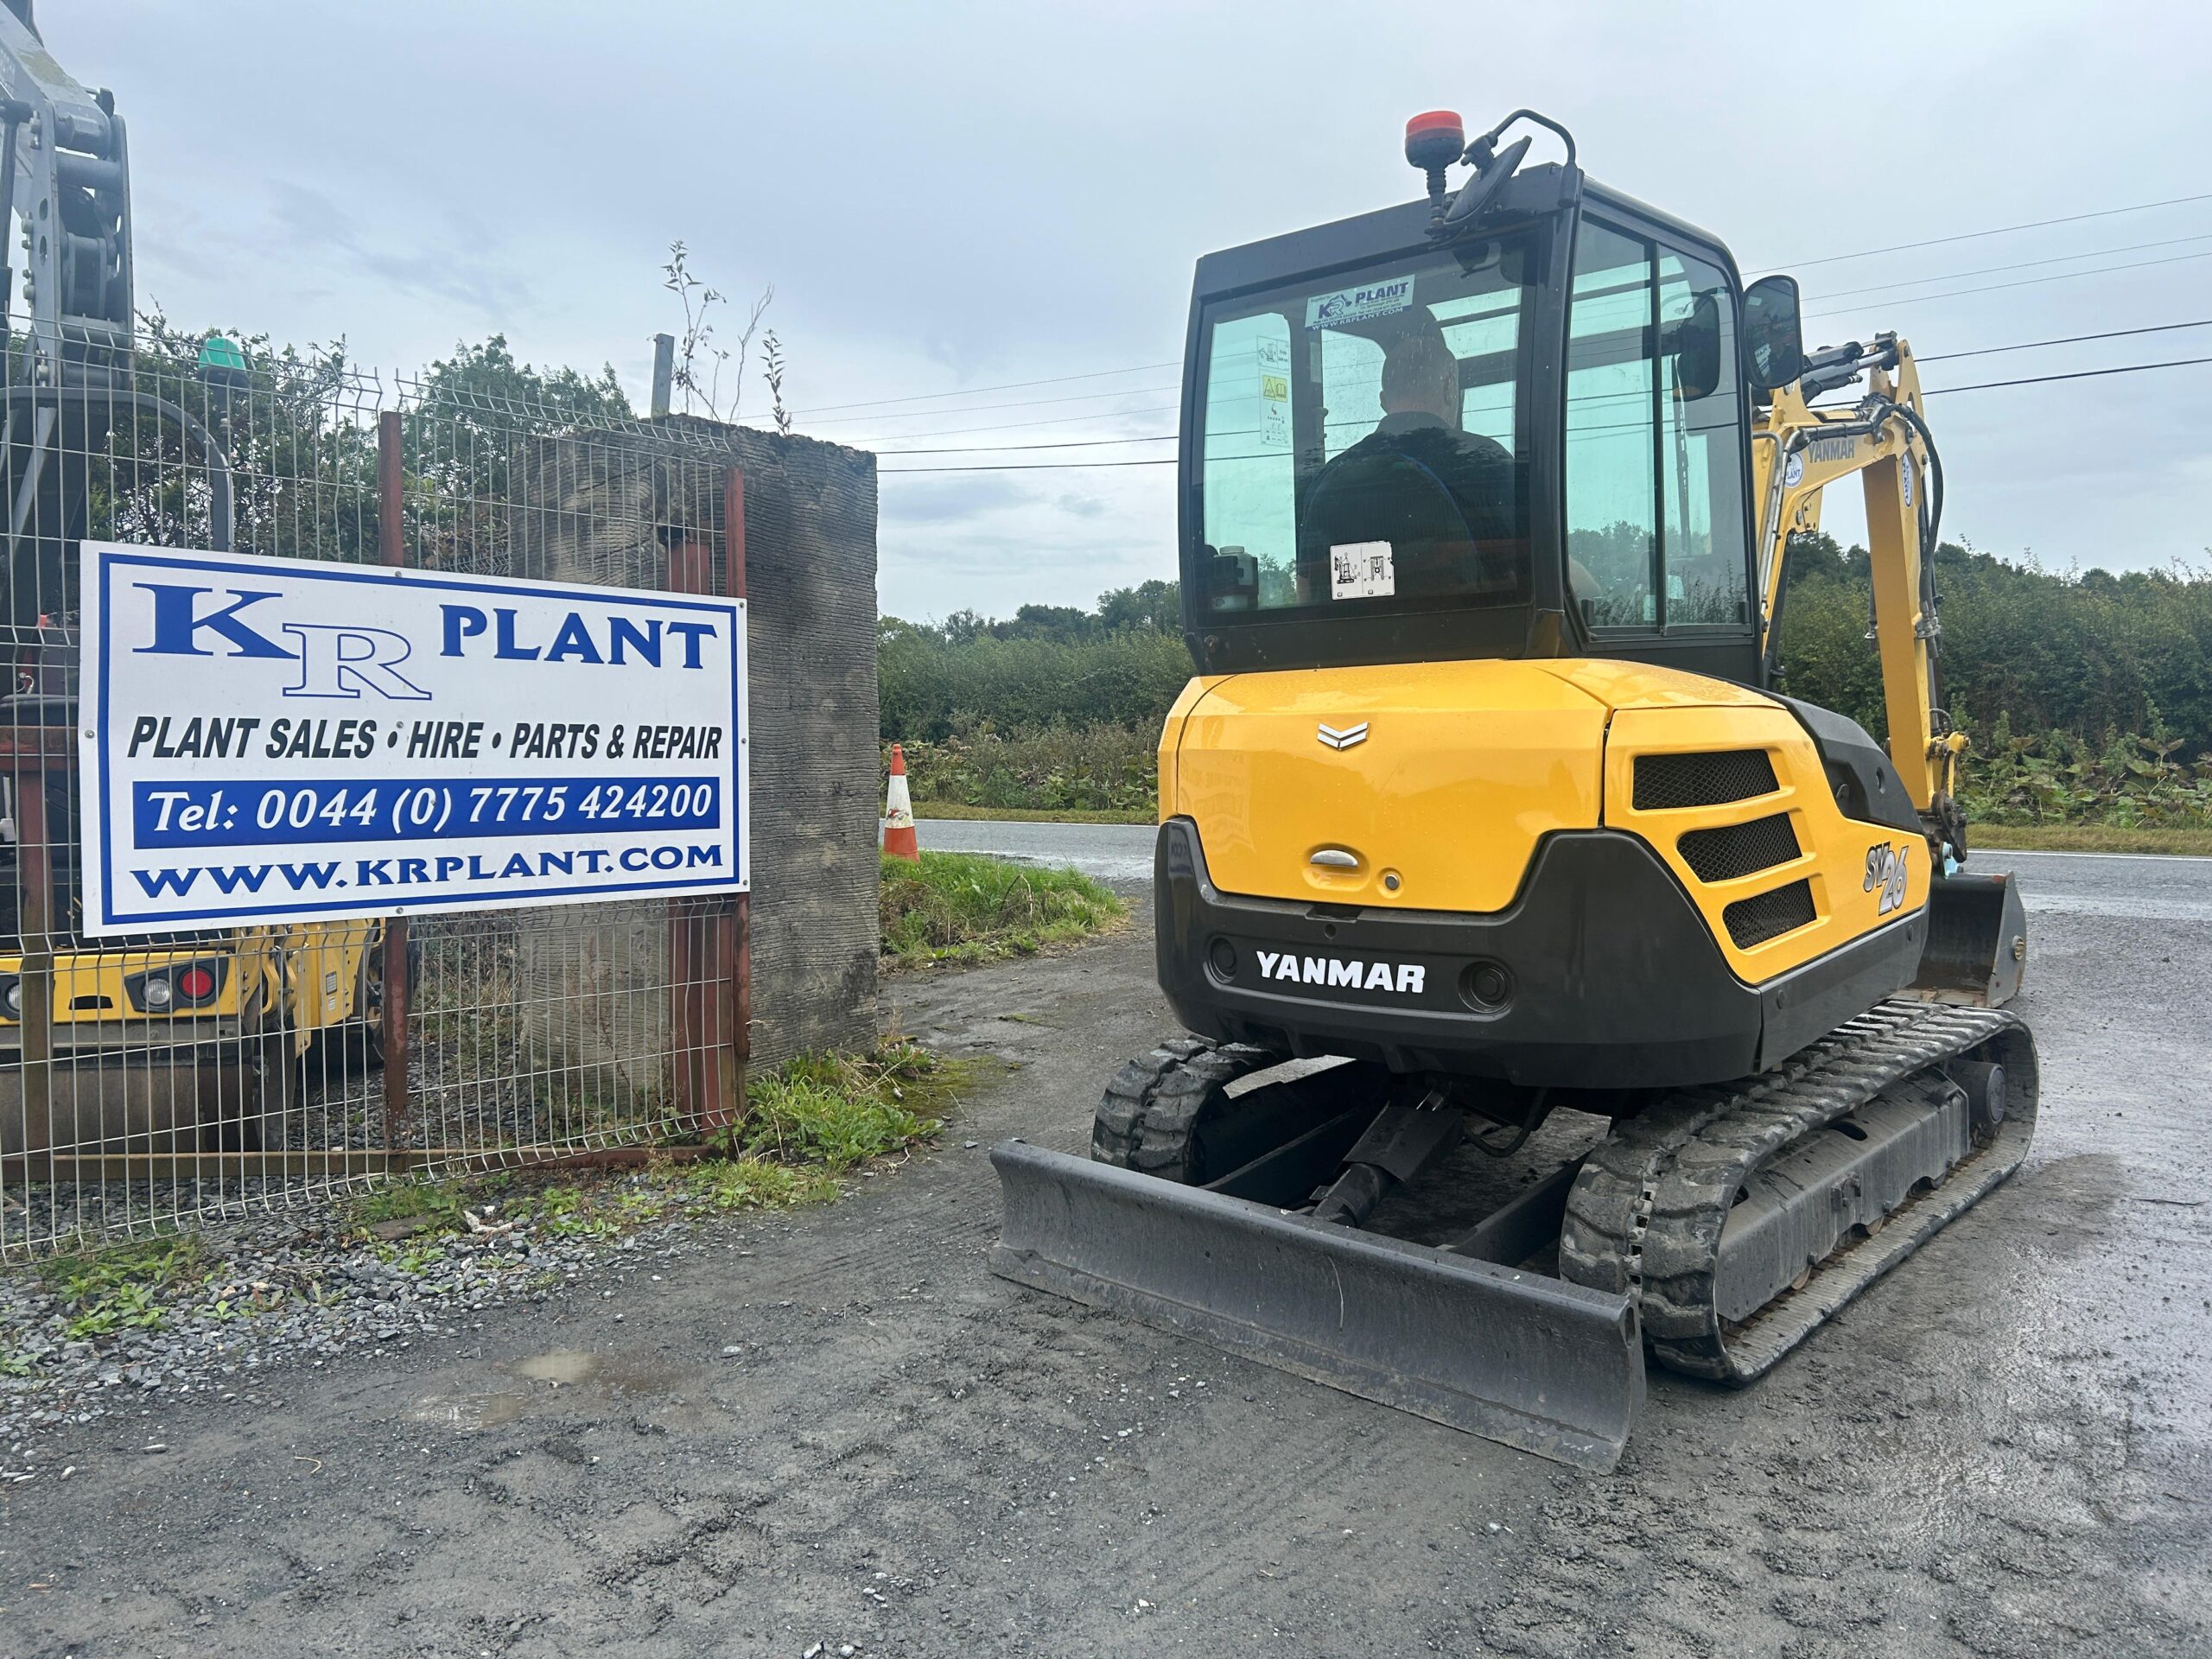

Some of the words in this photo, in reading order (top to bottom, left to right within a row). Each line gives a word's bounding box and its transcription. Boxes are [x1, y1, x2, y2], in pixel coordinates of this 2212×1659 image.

[1354, 281, 1409, 304] PLANT
[1312, 307, 1403, 331] WWW.KRPLANT.COM
[1808, 439, 1855, 464] YANMAR
[132, 582, 432, 701] KR
[439, 604, 718, 670] PLANT
[127, 716, 261, 759] PLANT
[265, 718, 378, 759] SALES
[406, 721, 485, 759] HIRE
[509, 722, 600, 759] PARTS
[606, 724, 626, 759] &
[632, 725, 722, 760] REPAIR
[147, 790, 238, 831] Tel:
[255, 788, 378, 830] 0044
[391, 786, 453, 834] (0)
[468, 785, 569, 823] 7775
[577, 784, 712, 819] 424200
[132, 843, 722, 899] WWW.KRPLANT.COM
[1255, 950, 1426, 994] YANMAR
